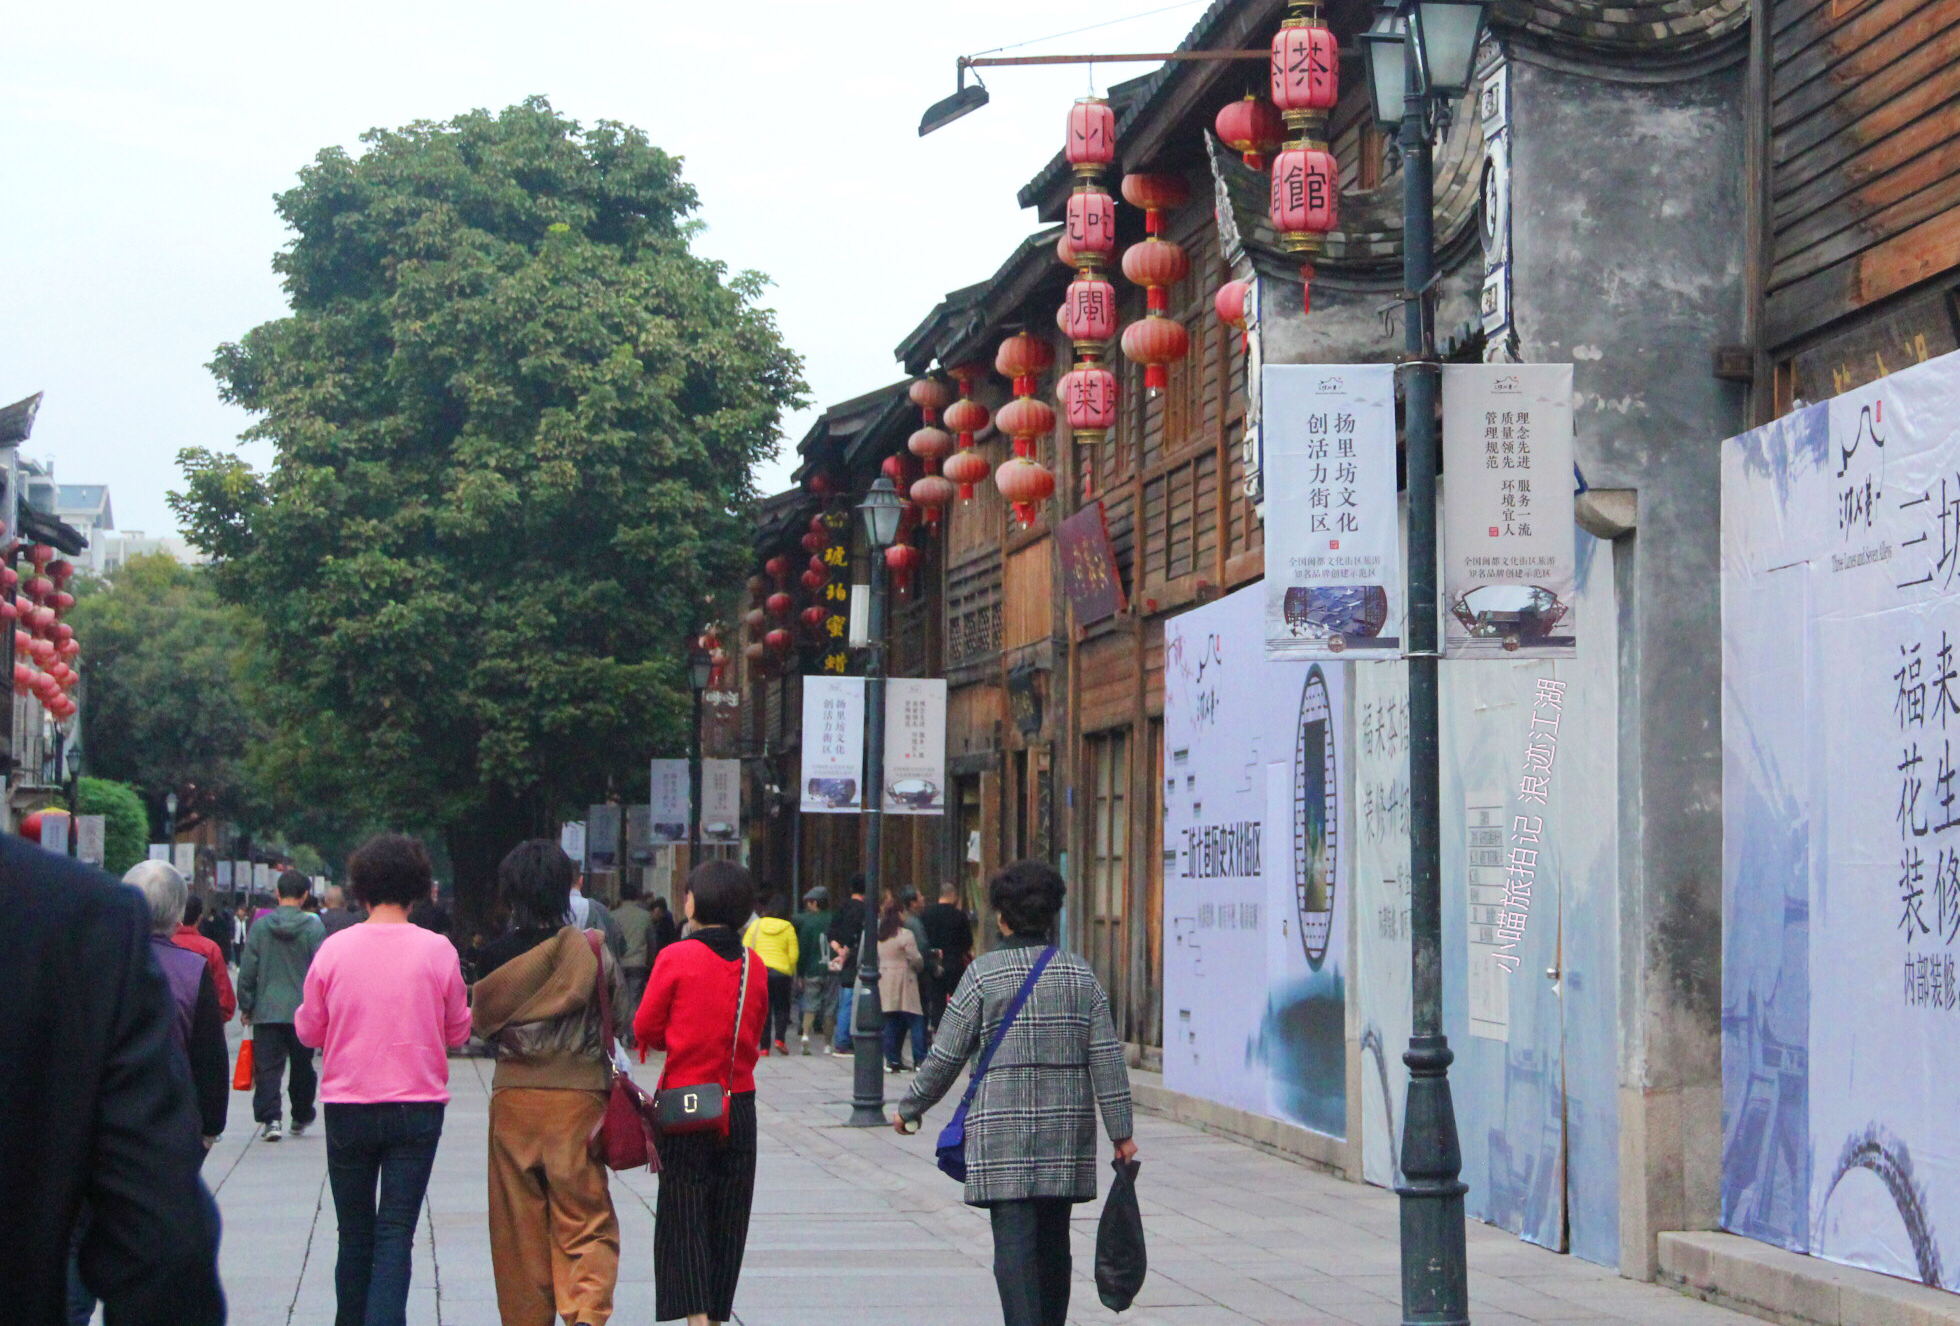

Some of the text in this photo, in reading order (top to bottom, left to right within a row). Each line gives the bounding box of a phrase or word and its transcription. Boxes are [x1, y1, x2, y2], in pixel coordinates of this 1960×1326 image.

[1485, 411, 1499, 470] 管理规范
[1501, 411, 1515, 470] 质量领先
[1307, 413, 1332, 533] 创活力街区
[1333, 412, 1359, 534] 扬里坊文化
[1516, 411, 1532, 537] 理念先进 服务一流
[1501, 479, 1516, 537] 环境宜人
[1288, 556, 1382, 568] 全国闽都文化街区旅游
[1294, 568, 1377, 579] 知名品牌创建示范区
[1464, 555, 1556, 567] 全国闽都文化街区旅游
[1469, 568, 1552, 579] 知名品牌创建示范区
[1181, 820, 1261, 879] 三坊七巷历史文化街区
